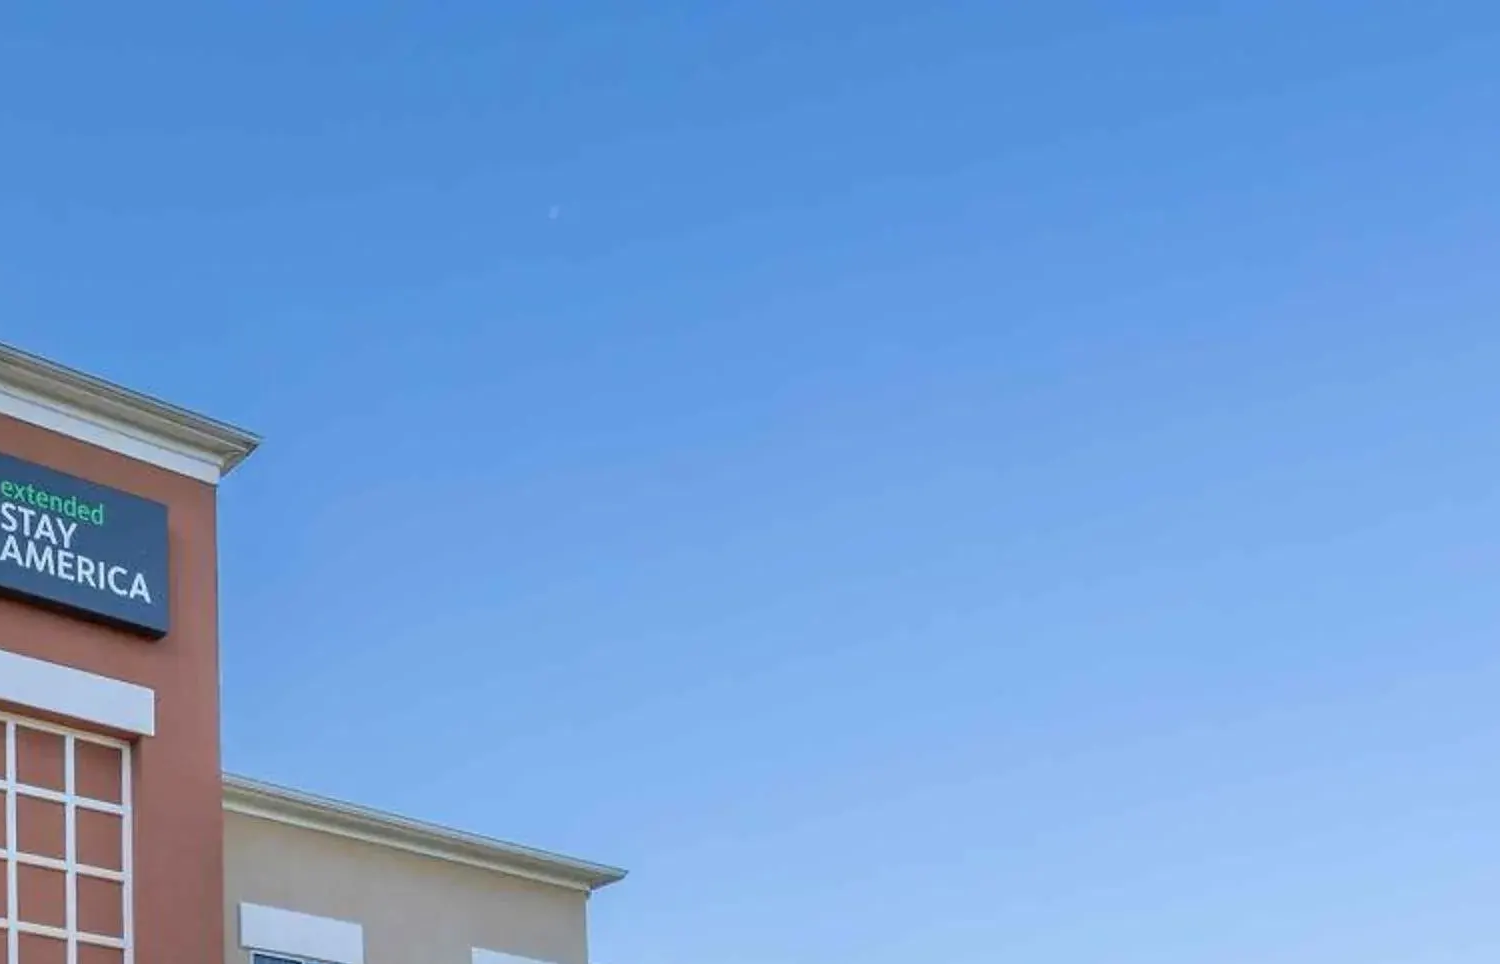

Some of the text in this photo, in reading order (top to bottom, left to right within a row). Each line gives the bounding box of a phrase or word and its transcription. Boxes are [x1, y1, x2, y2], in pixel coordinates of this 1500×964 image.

[1, 480, 104, 525] extended
[0, 503, 77, 549] STAY
[0, 535, 152, 604] AMERICA
